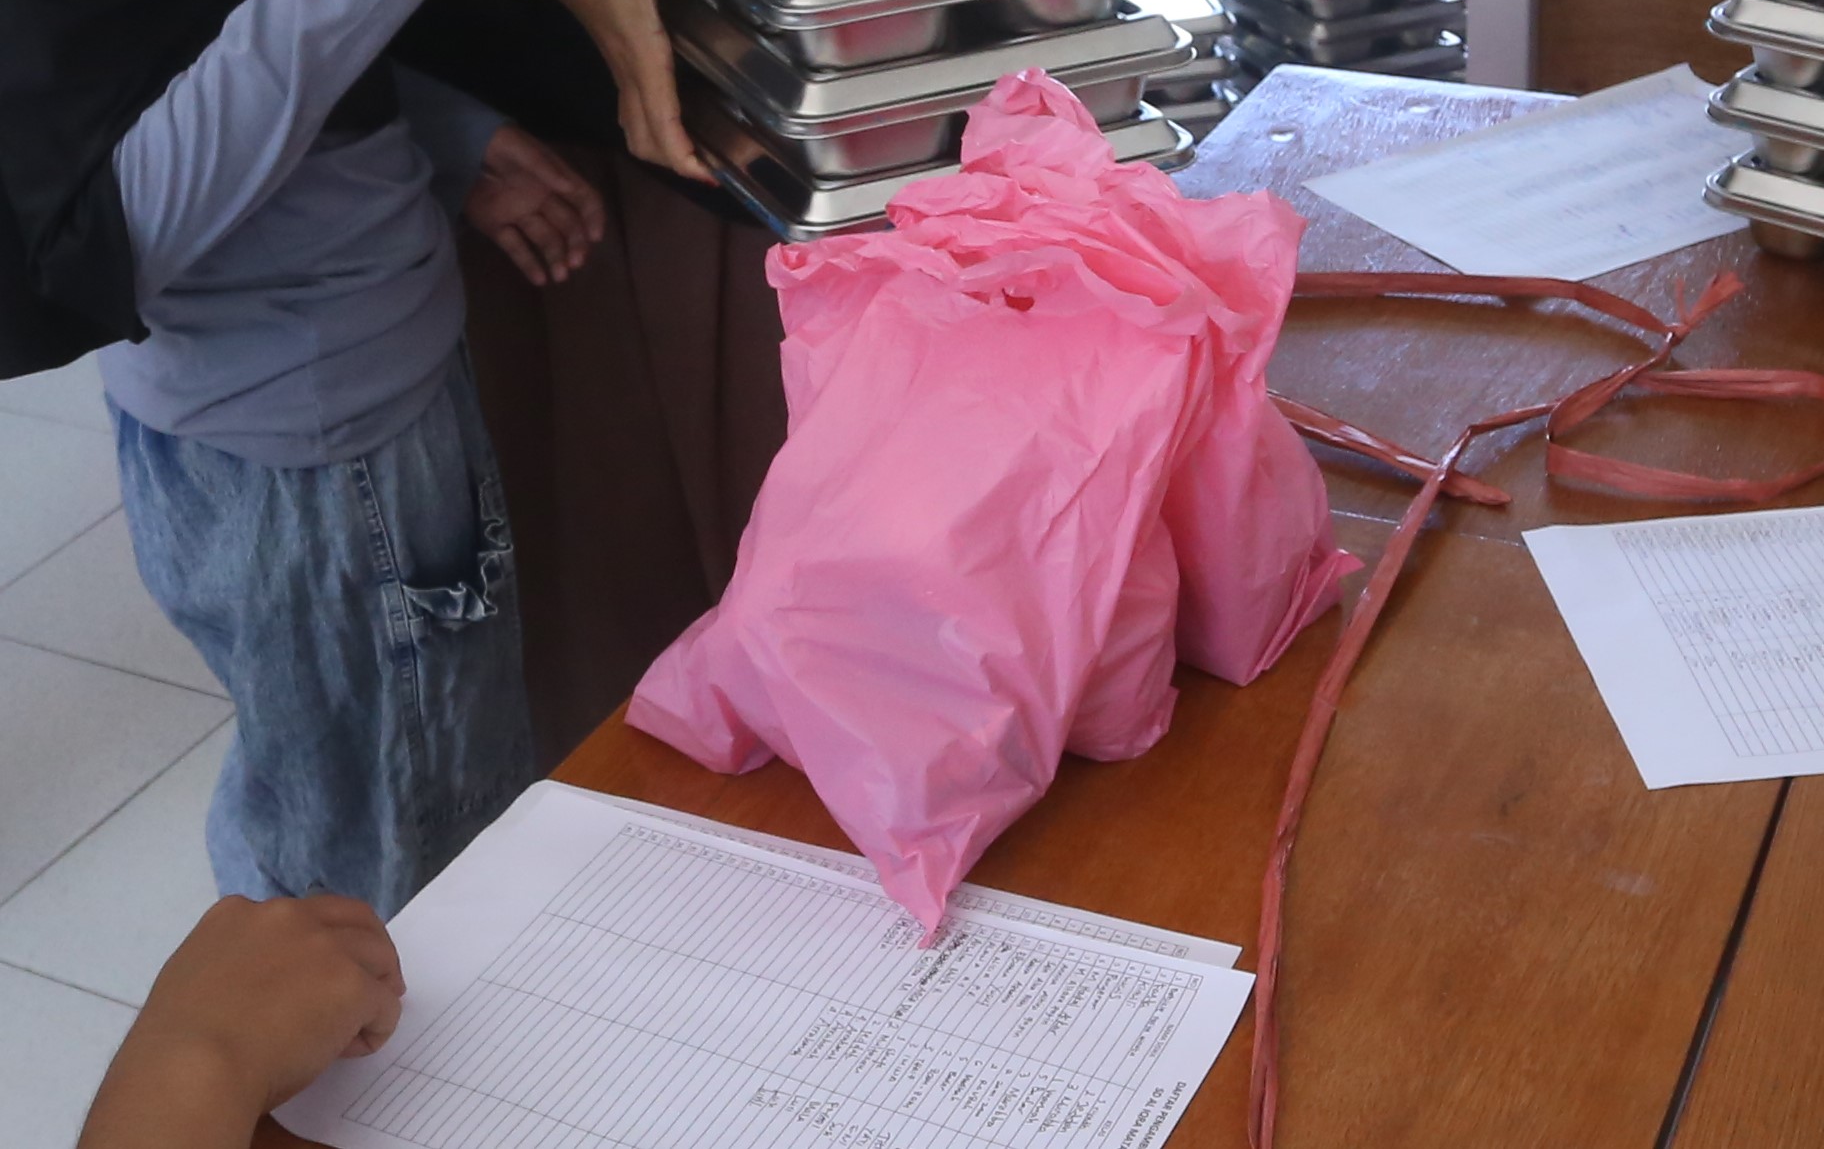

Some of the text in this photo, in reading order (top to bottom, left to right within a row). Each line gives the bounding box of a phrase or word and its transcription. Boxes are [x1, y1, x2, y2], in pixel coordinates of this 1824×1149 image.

[1150, 1086, 1165, 1098] SD
[1161, 1080, 1187, 1111] DAFTAR
[1144, 1097, 1158, 1109] AL
[1131, 1107, 1151, 1129] IQRA
